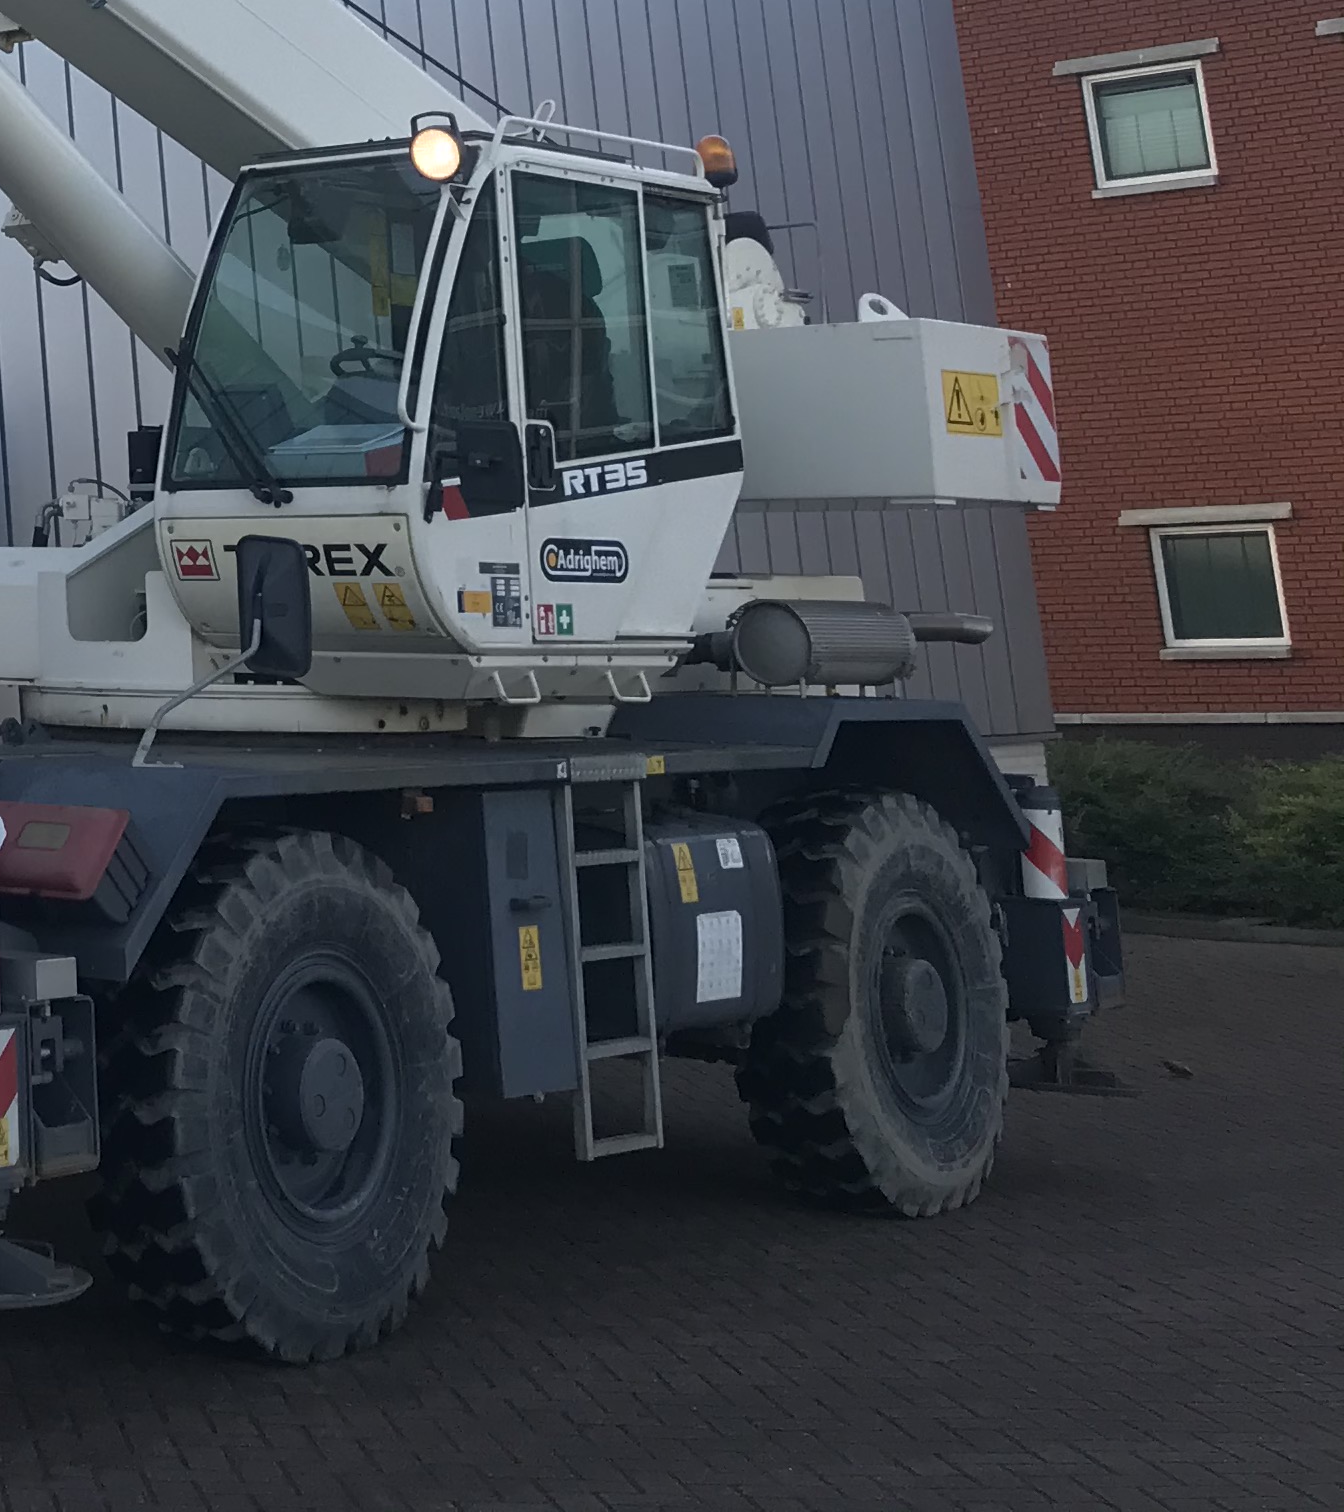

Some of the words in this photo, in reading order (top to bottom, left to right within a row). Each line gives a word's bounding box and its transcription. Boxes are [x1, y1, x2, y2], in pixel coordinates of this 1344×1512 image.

[562, 460, 647, 496] RT35
[223, 543, 396, 577] REX
[556, 546, 619, 577] Adrighem
